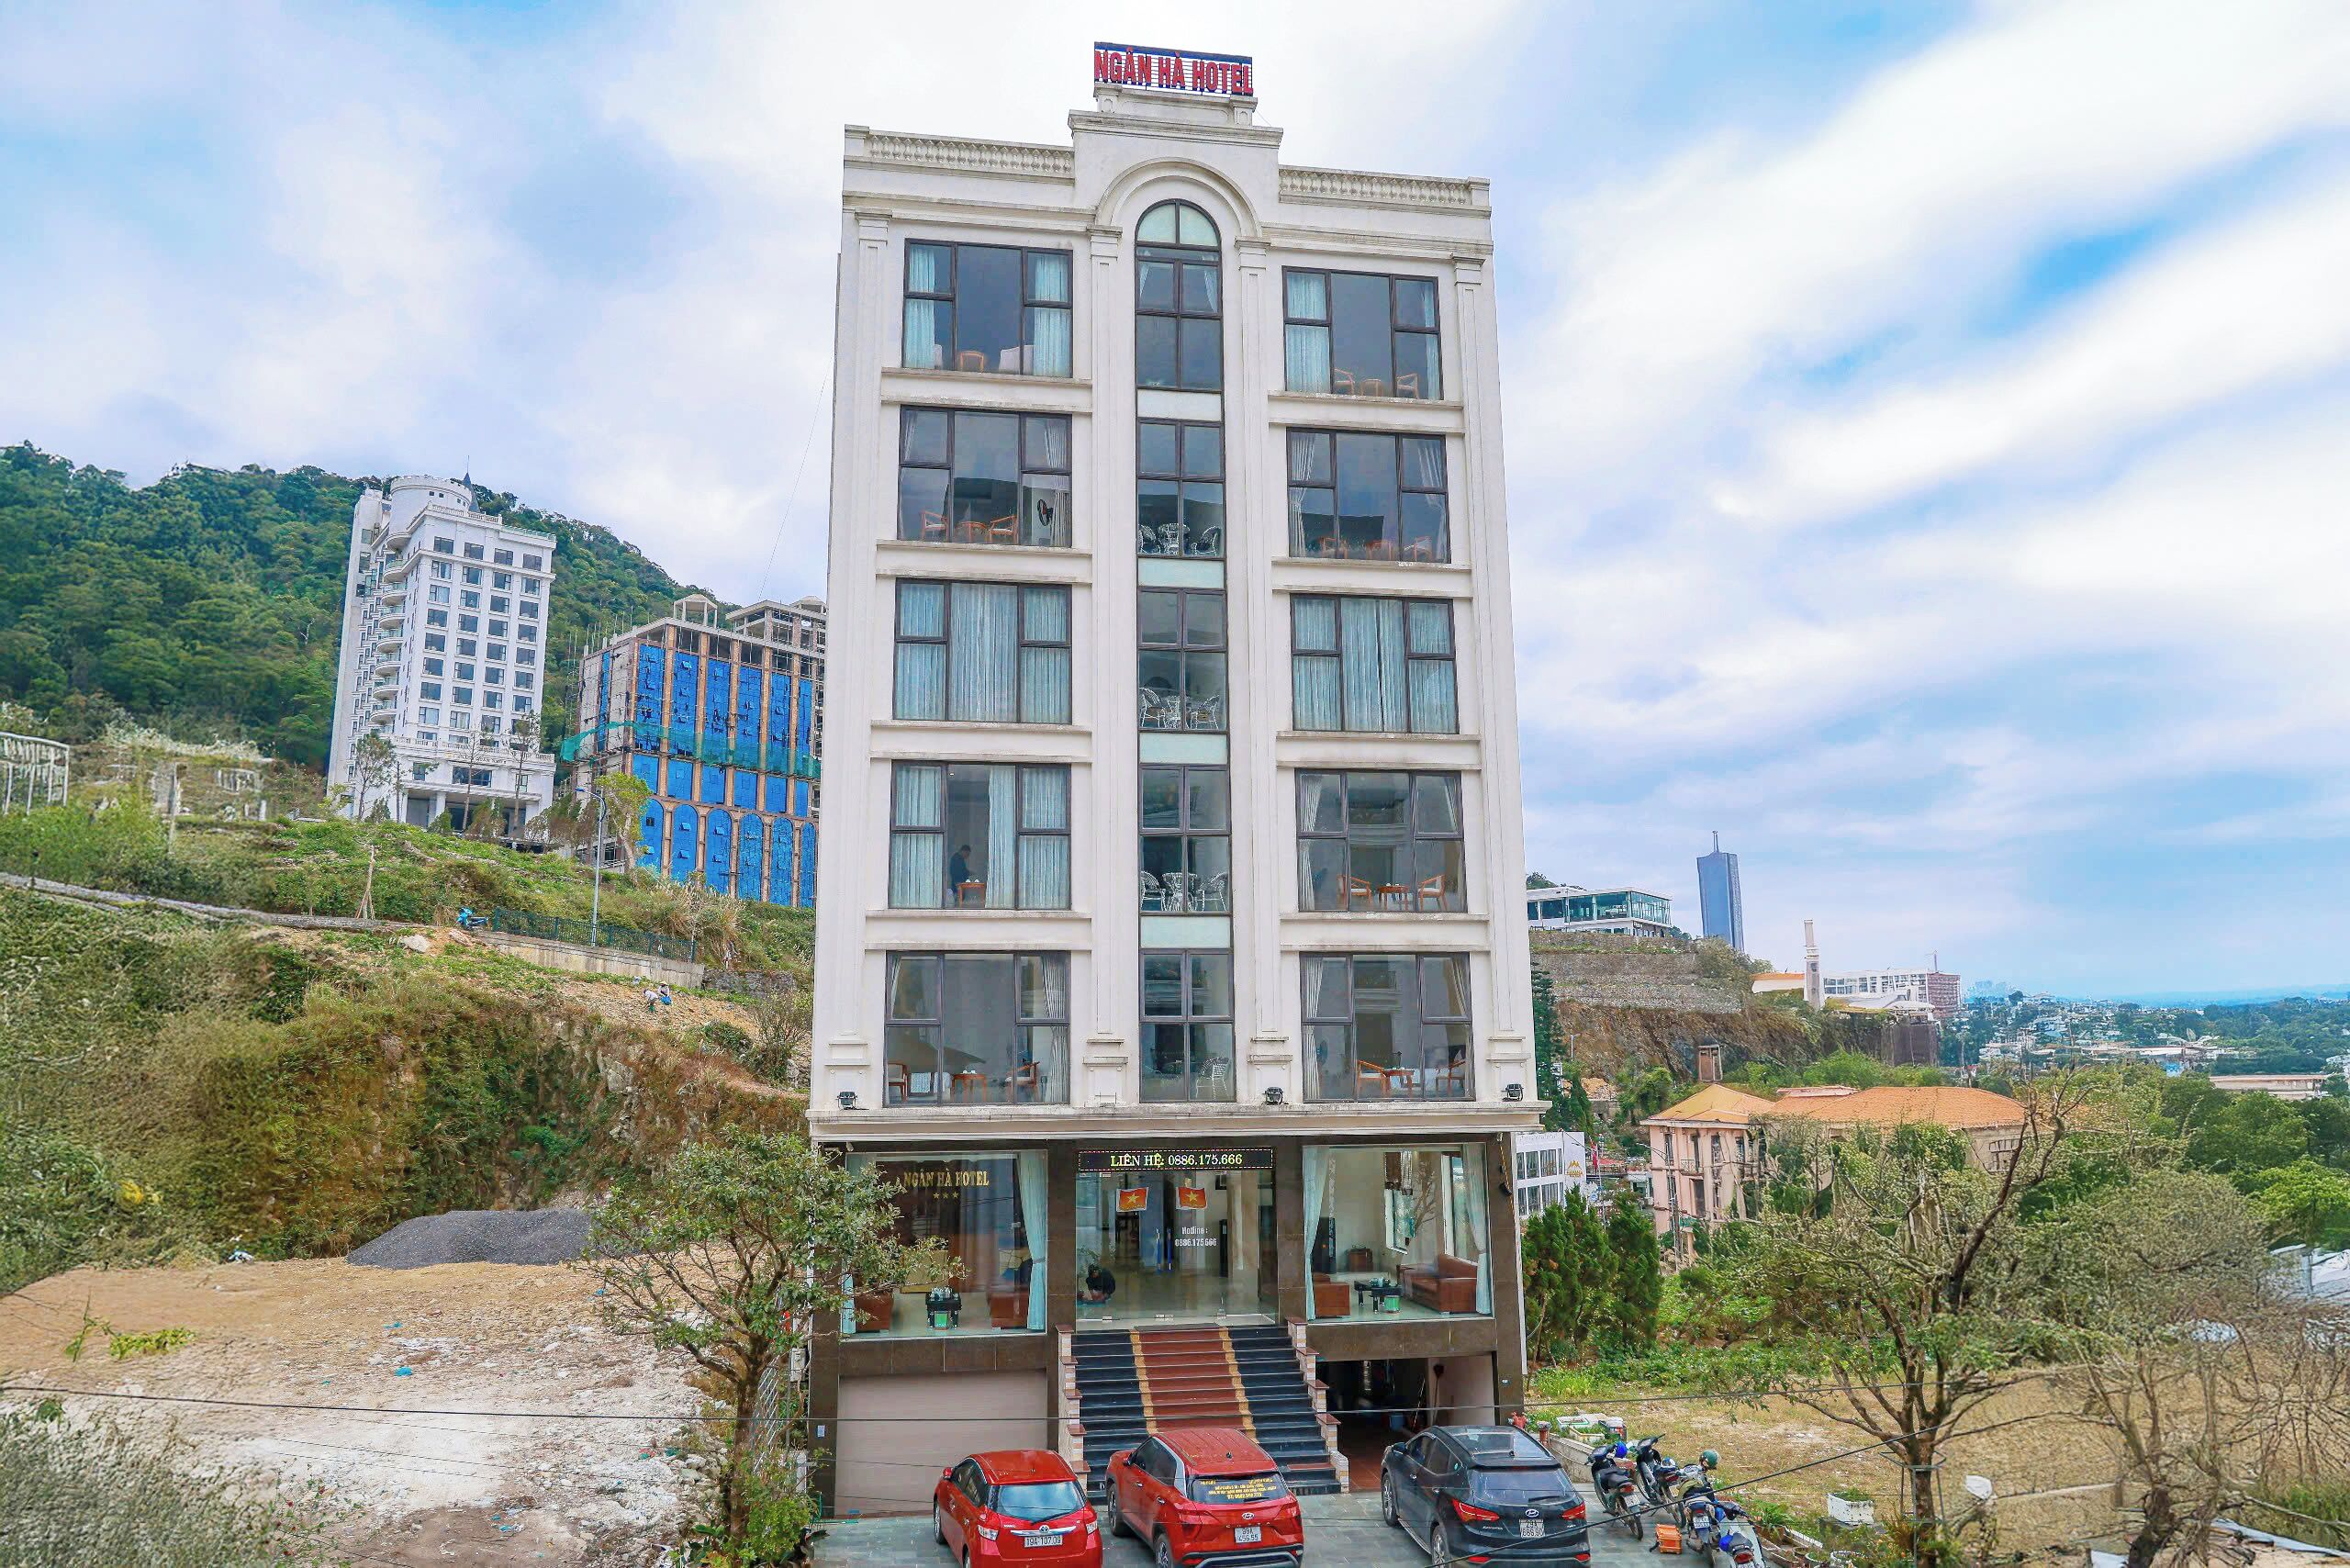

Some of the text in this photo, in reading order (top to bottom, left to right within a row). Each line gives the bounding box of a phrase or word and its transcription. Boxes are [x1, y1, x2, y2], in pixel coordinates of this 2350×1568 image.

[1094, 46, 1254, 96] NGÂN HÀ HOTEL
[1110, 1153, 1141, 1167] LIÊN
[1168, 1153, 1243, 1166] 0886.175.666
[904, 1167, 990, 1188] NGÂN HÀ HOTEL
[1181, 1226, 1204, 1235] Hotline
